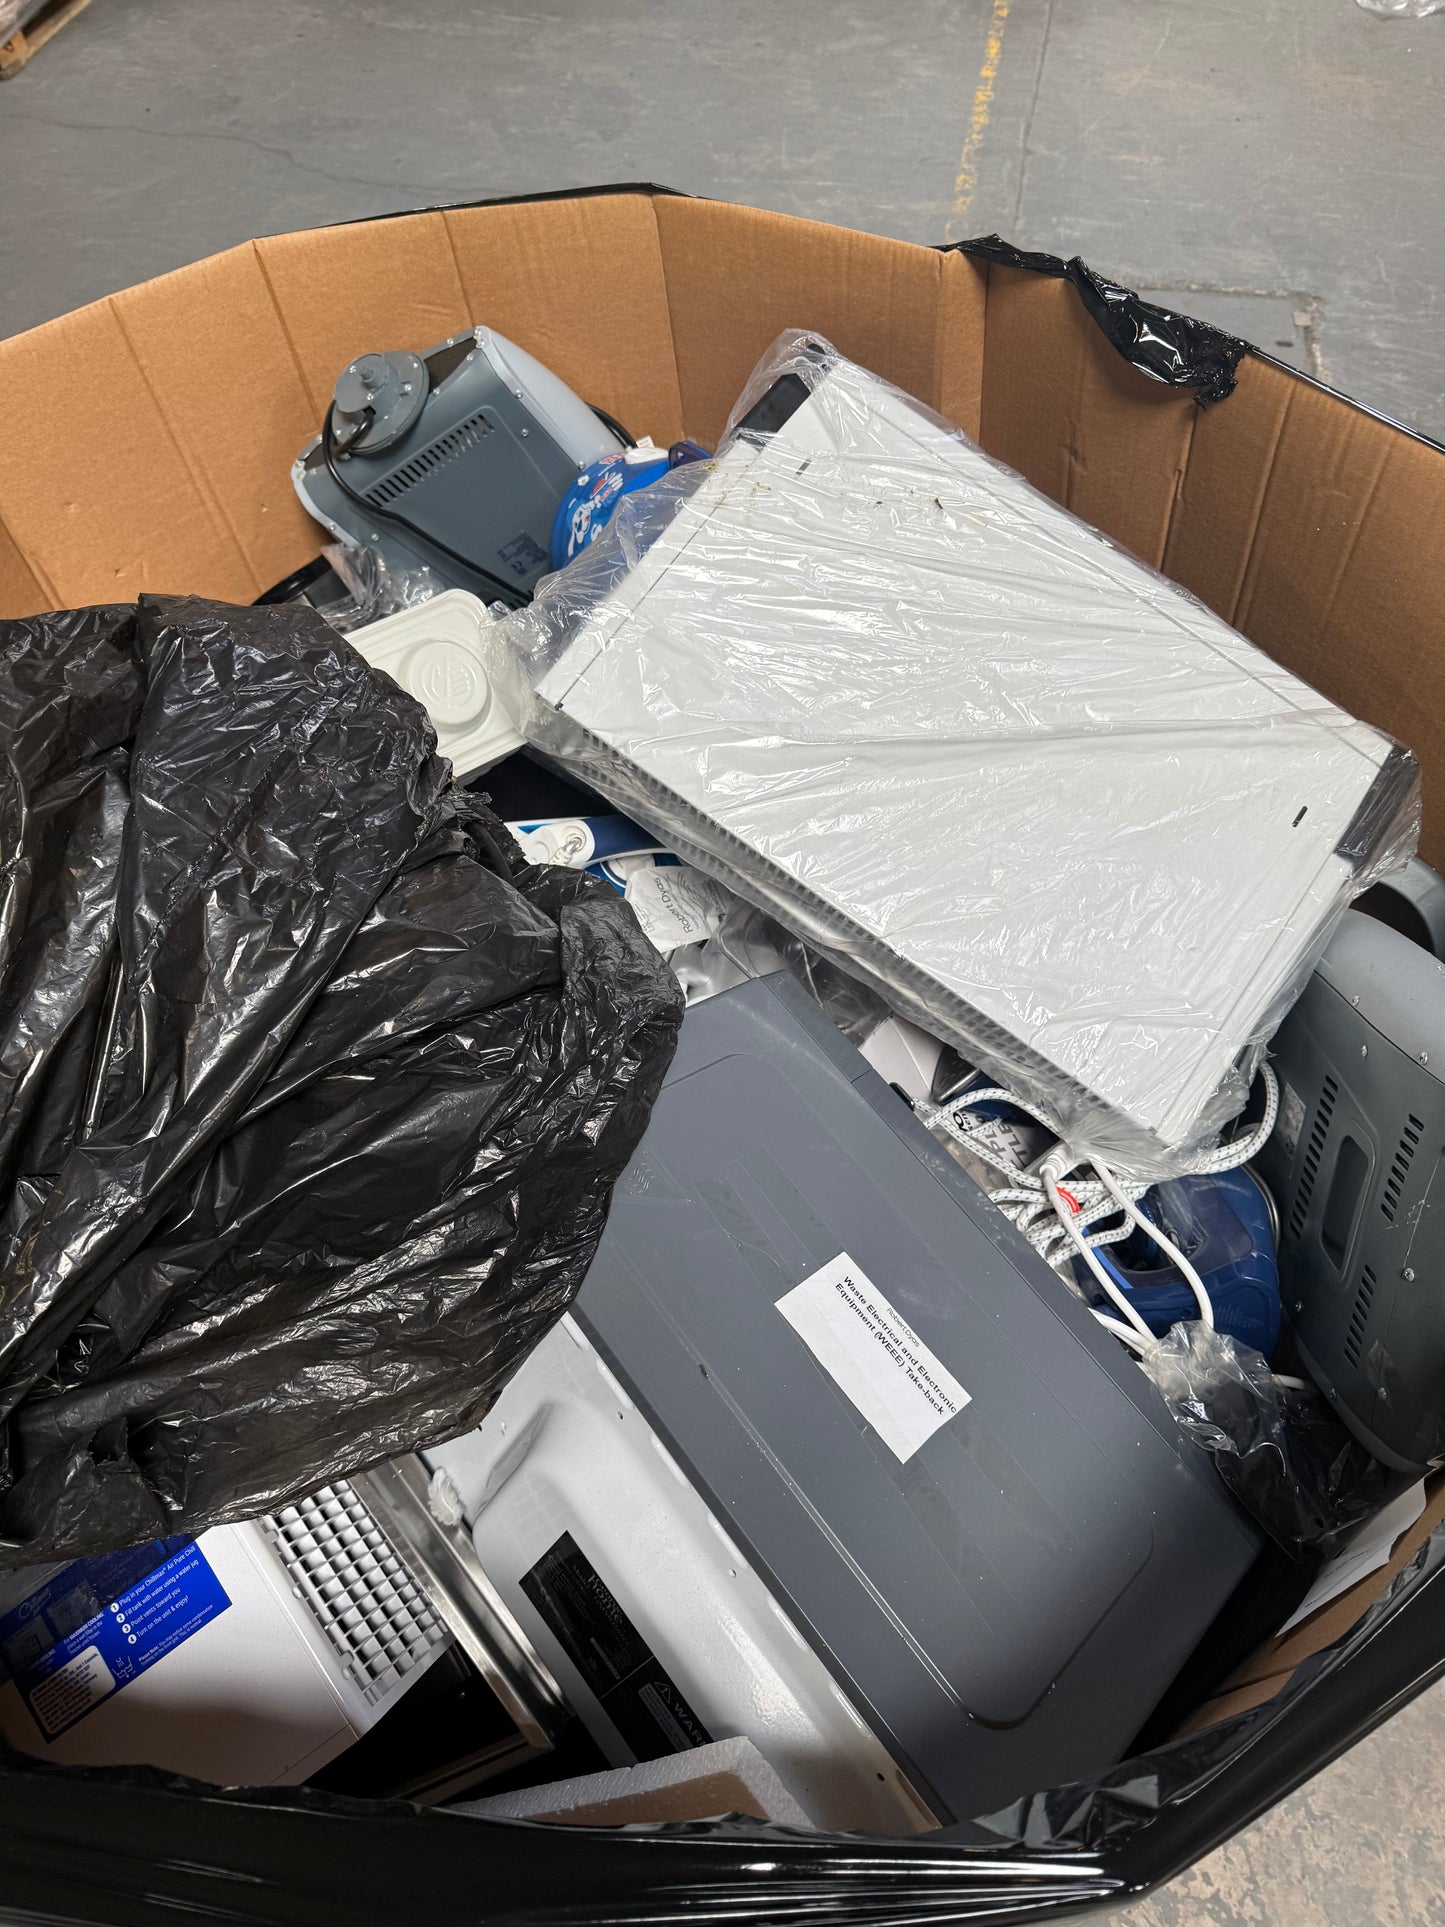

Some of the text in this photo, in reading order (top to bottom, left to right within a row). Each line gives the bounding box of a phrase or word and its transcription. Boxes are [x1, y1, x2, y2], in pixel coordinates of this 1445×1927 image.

[654, 877, 671, 904] Dyas
[665, 902, 694, 934] Robert
[835, 1283, 944, 1415] Equipment (WEEE) Take-back
[843, 1276, 957, 1413] Waste Electrical and Electronic
[887, 1307, 920, 1348] Robert Dyas
[119, 1595, 130, 1607] Plug
[134, 1584, 146, 1595] your
[166, 1561, 175, 1570] Air
[173, 1553, 185, 1564] Pure
[184, 1545, 196, 1556] Chill
[131, 1601, 142, 1611] tank
[141, 1594, 151, 1604] with
[150, 1585, 163, 1597] water
[163, 1576, 176, 1588] using
[178, 1564, 191, 1576] water
[190, 1559, 199, 1568] jug
[130, 1615, 143, 1627] Point
[143, 1606, 156, 1617] vents
[155, 1593, 172, 1608] toward
[171, 1587, 181, 1597] you
[136, 1626, 147, 1637] Turn
[153, 1616, 162, 1624] the
[161, 1609, 171, 1618] unit
[174, 1595, 189, 1609] enjoy!
[588, 1575, 622, 1624] home
[674, 1702, 708, 1746] WAR
